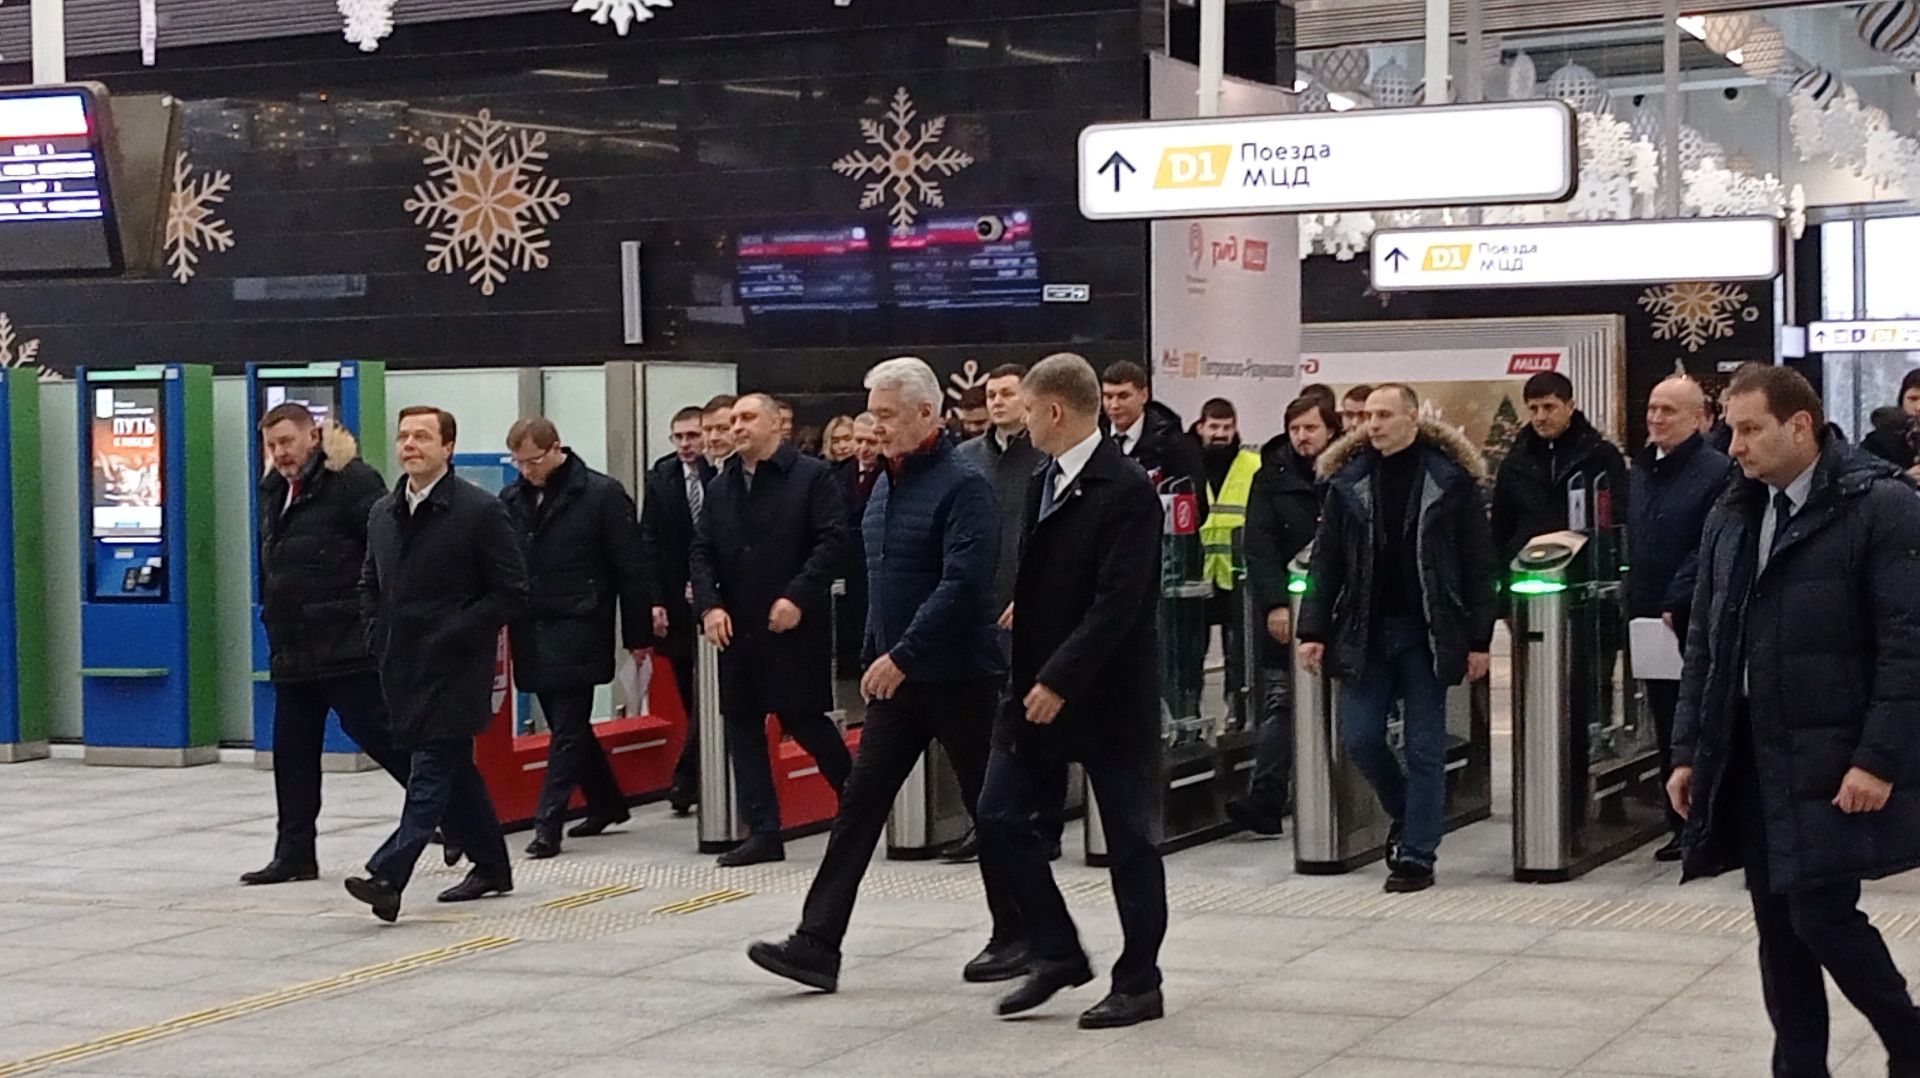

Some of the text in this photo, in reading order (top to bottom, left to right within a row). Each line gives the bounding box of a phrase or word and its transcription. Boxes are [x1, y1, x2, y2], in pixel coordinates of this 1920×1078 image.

[1241, 142, 1331, 162] Поезда
[1167, 152, 1217, 182] D1
[1242, 166, 1310, 188] МЦД
[1430, 247, 1464, 268] D1
[1479, 242, 1538, 254] Поезда
[1480, 258, 1523, 271] МЦД
[113, 418, 157, 435] ПУТЬ
